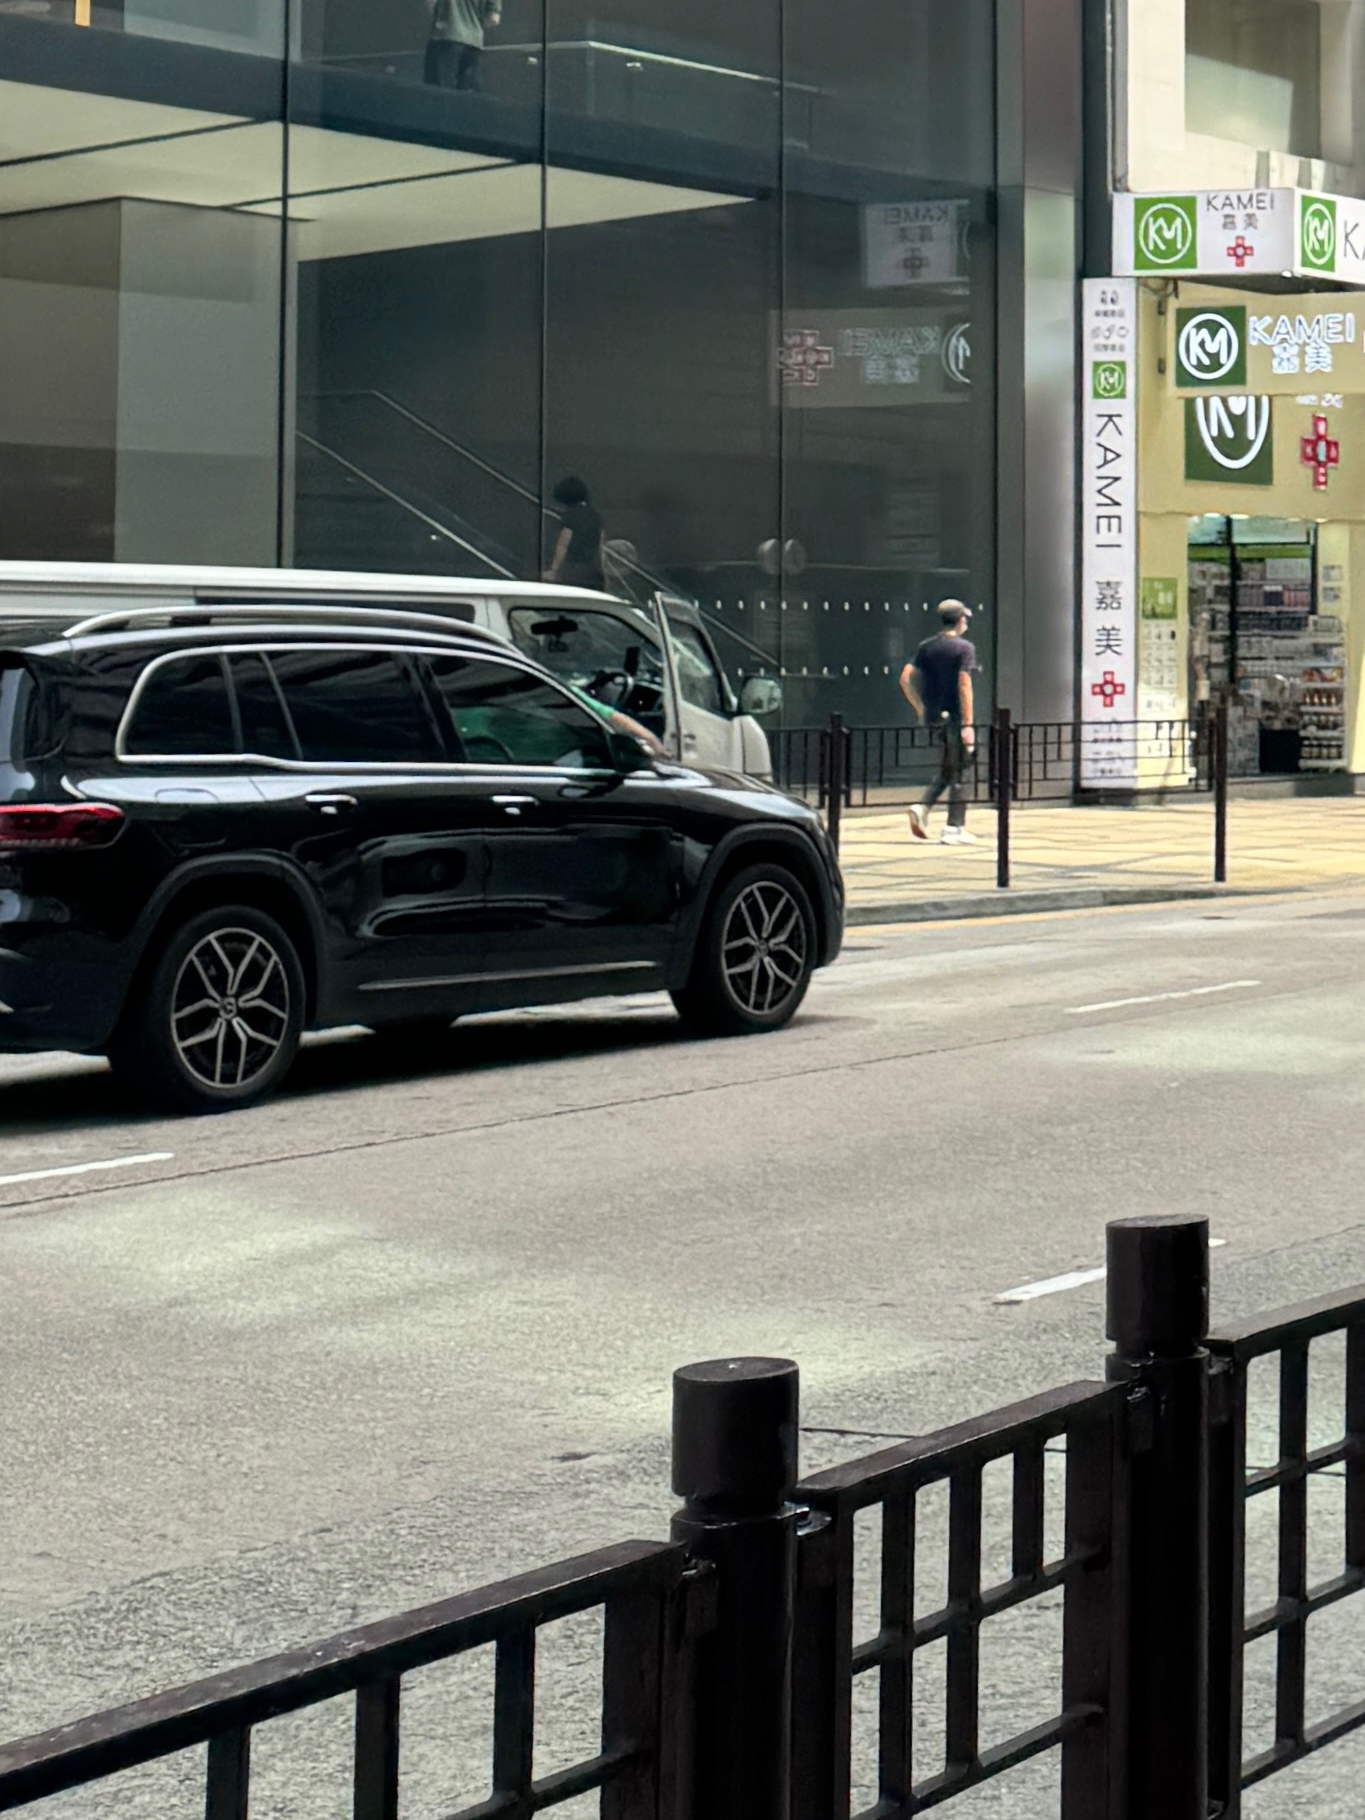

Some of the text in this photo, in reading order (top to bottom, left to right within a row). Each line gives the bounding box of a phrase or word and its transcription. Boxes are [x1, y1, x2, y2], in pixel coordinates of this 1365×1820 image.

[1206, 192, 1275, 212] KAMEI
[1249, 311, 1355, 346] KAMEI
[1095, 413, 1123, 549] KAMEI
[1094, 580, 1123, 656] 嘉美
